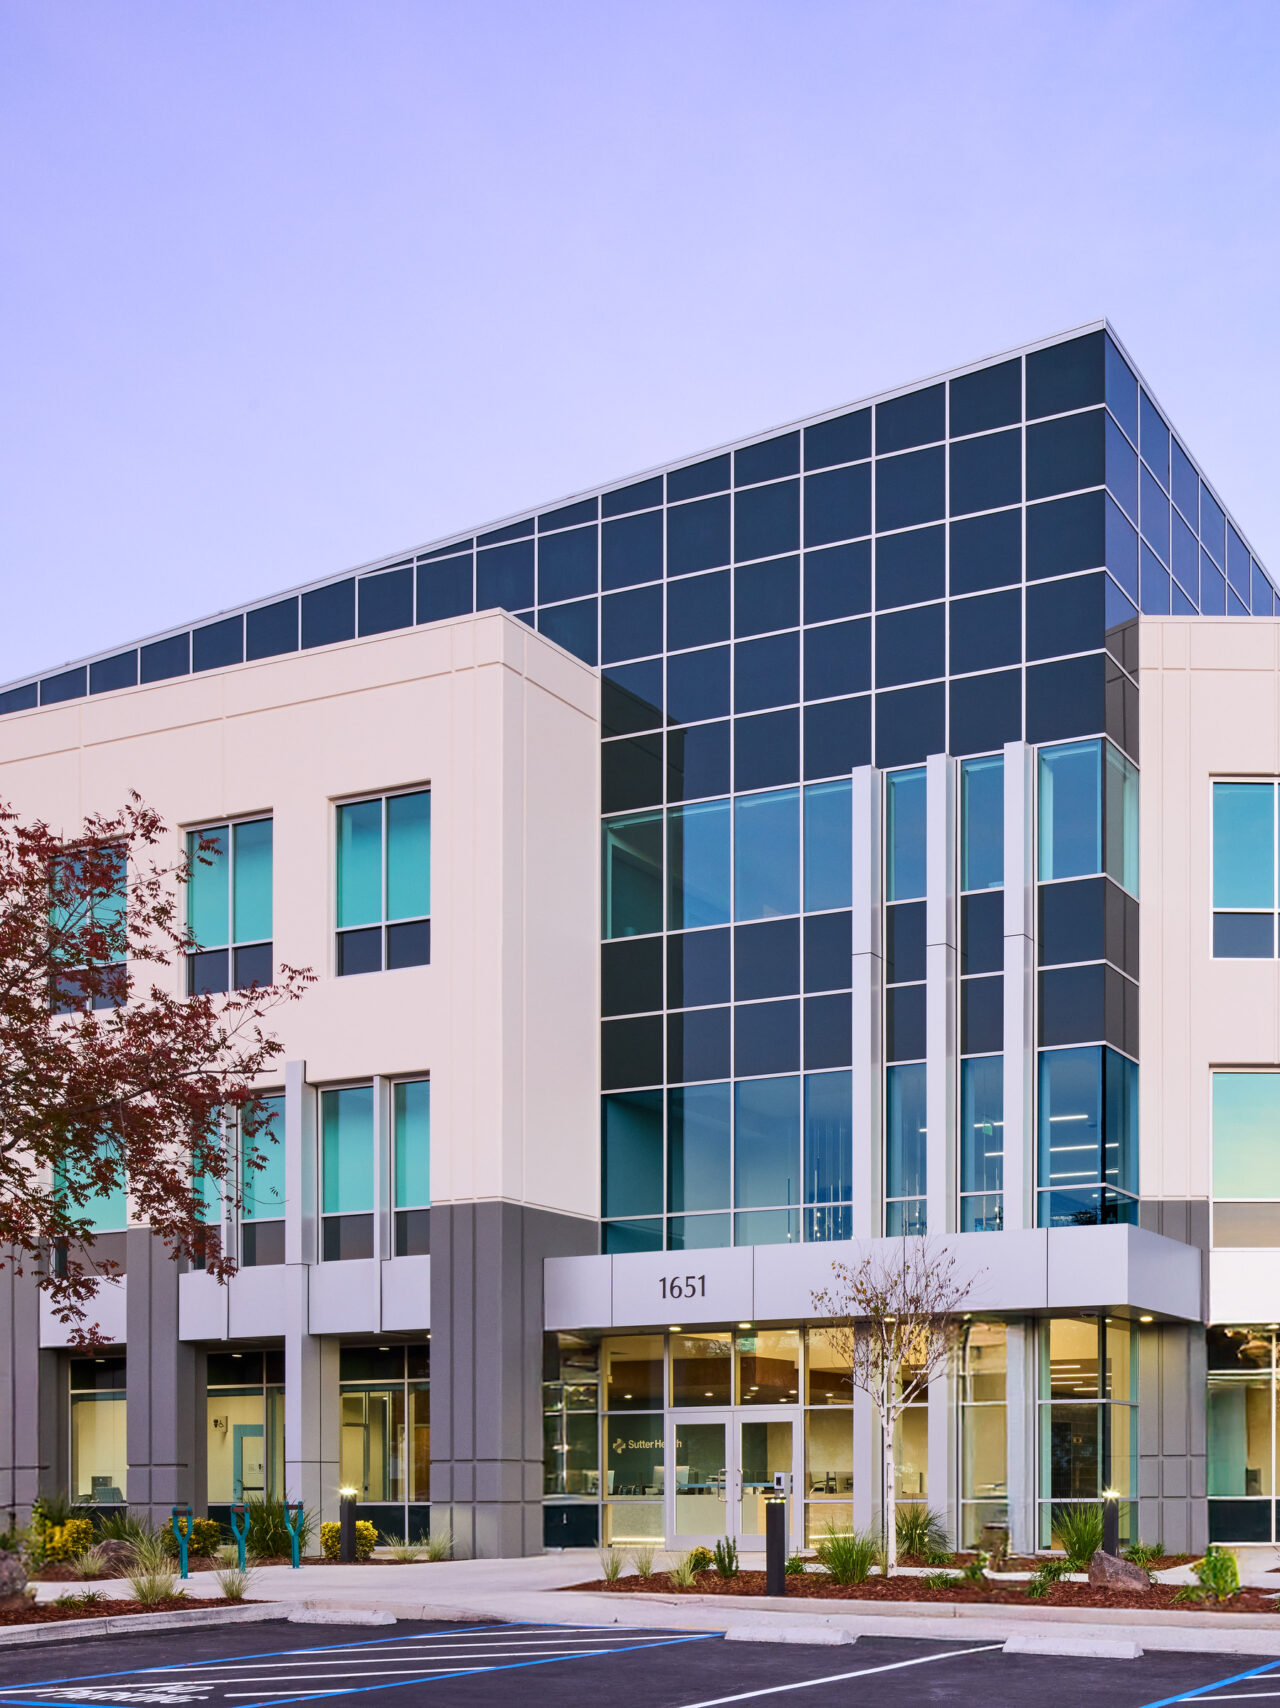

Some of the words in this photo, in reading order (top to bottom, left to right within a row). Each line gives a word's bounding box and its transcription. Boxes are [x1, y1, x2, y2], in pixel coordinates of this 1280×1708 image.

[659, 1275, 705, 1299] 1651
[628, 1440, 654, 1449] Sutter
[138, 1684, 215, 1693] NO
[36, 1689, 209, 1704] PARKING
